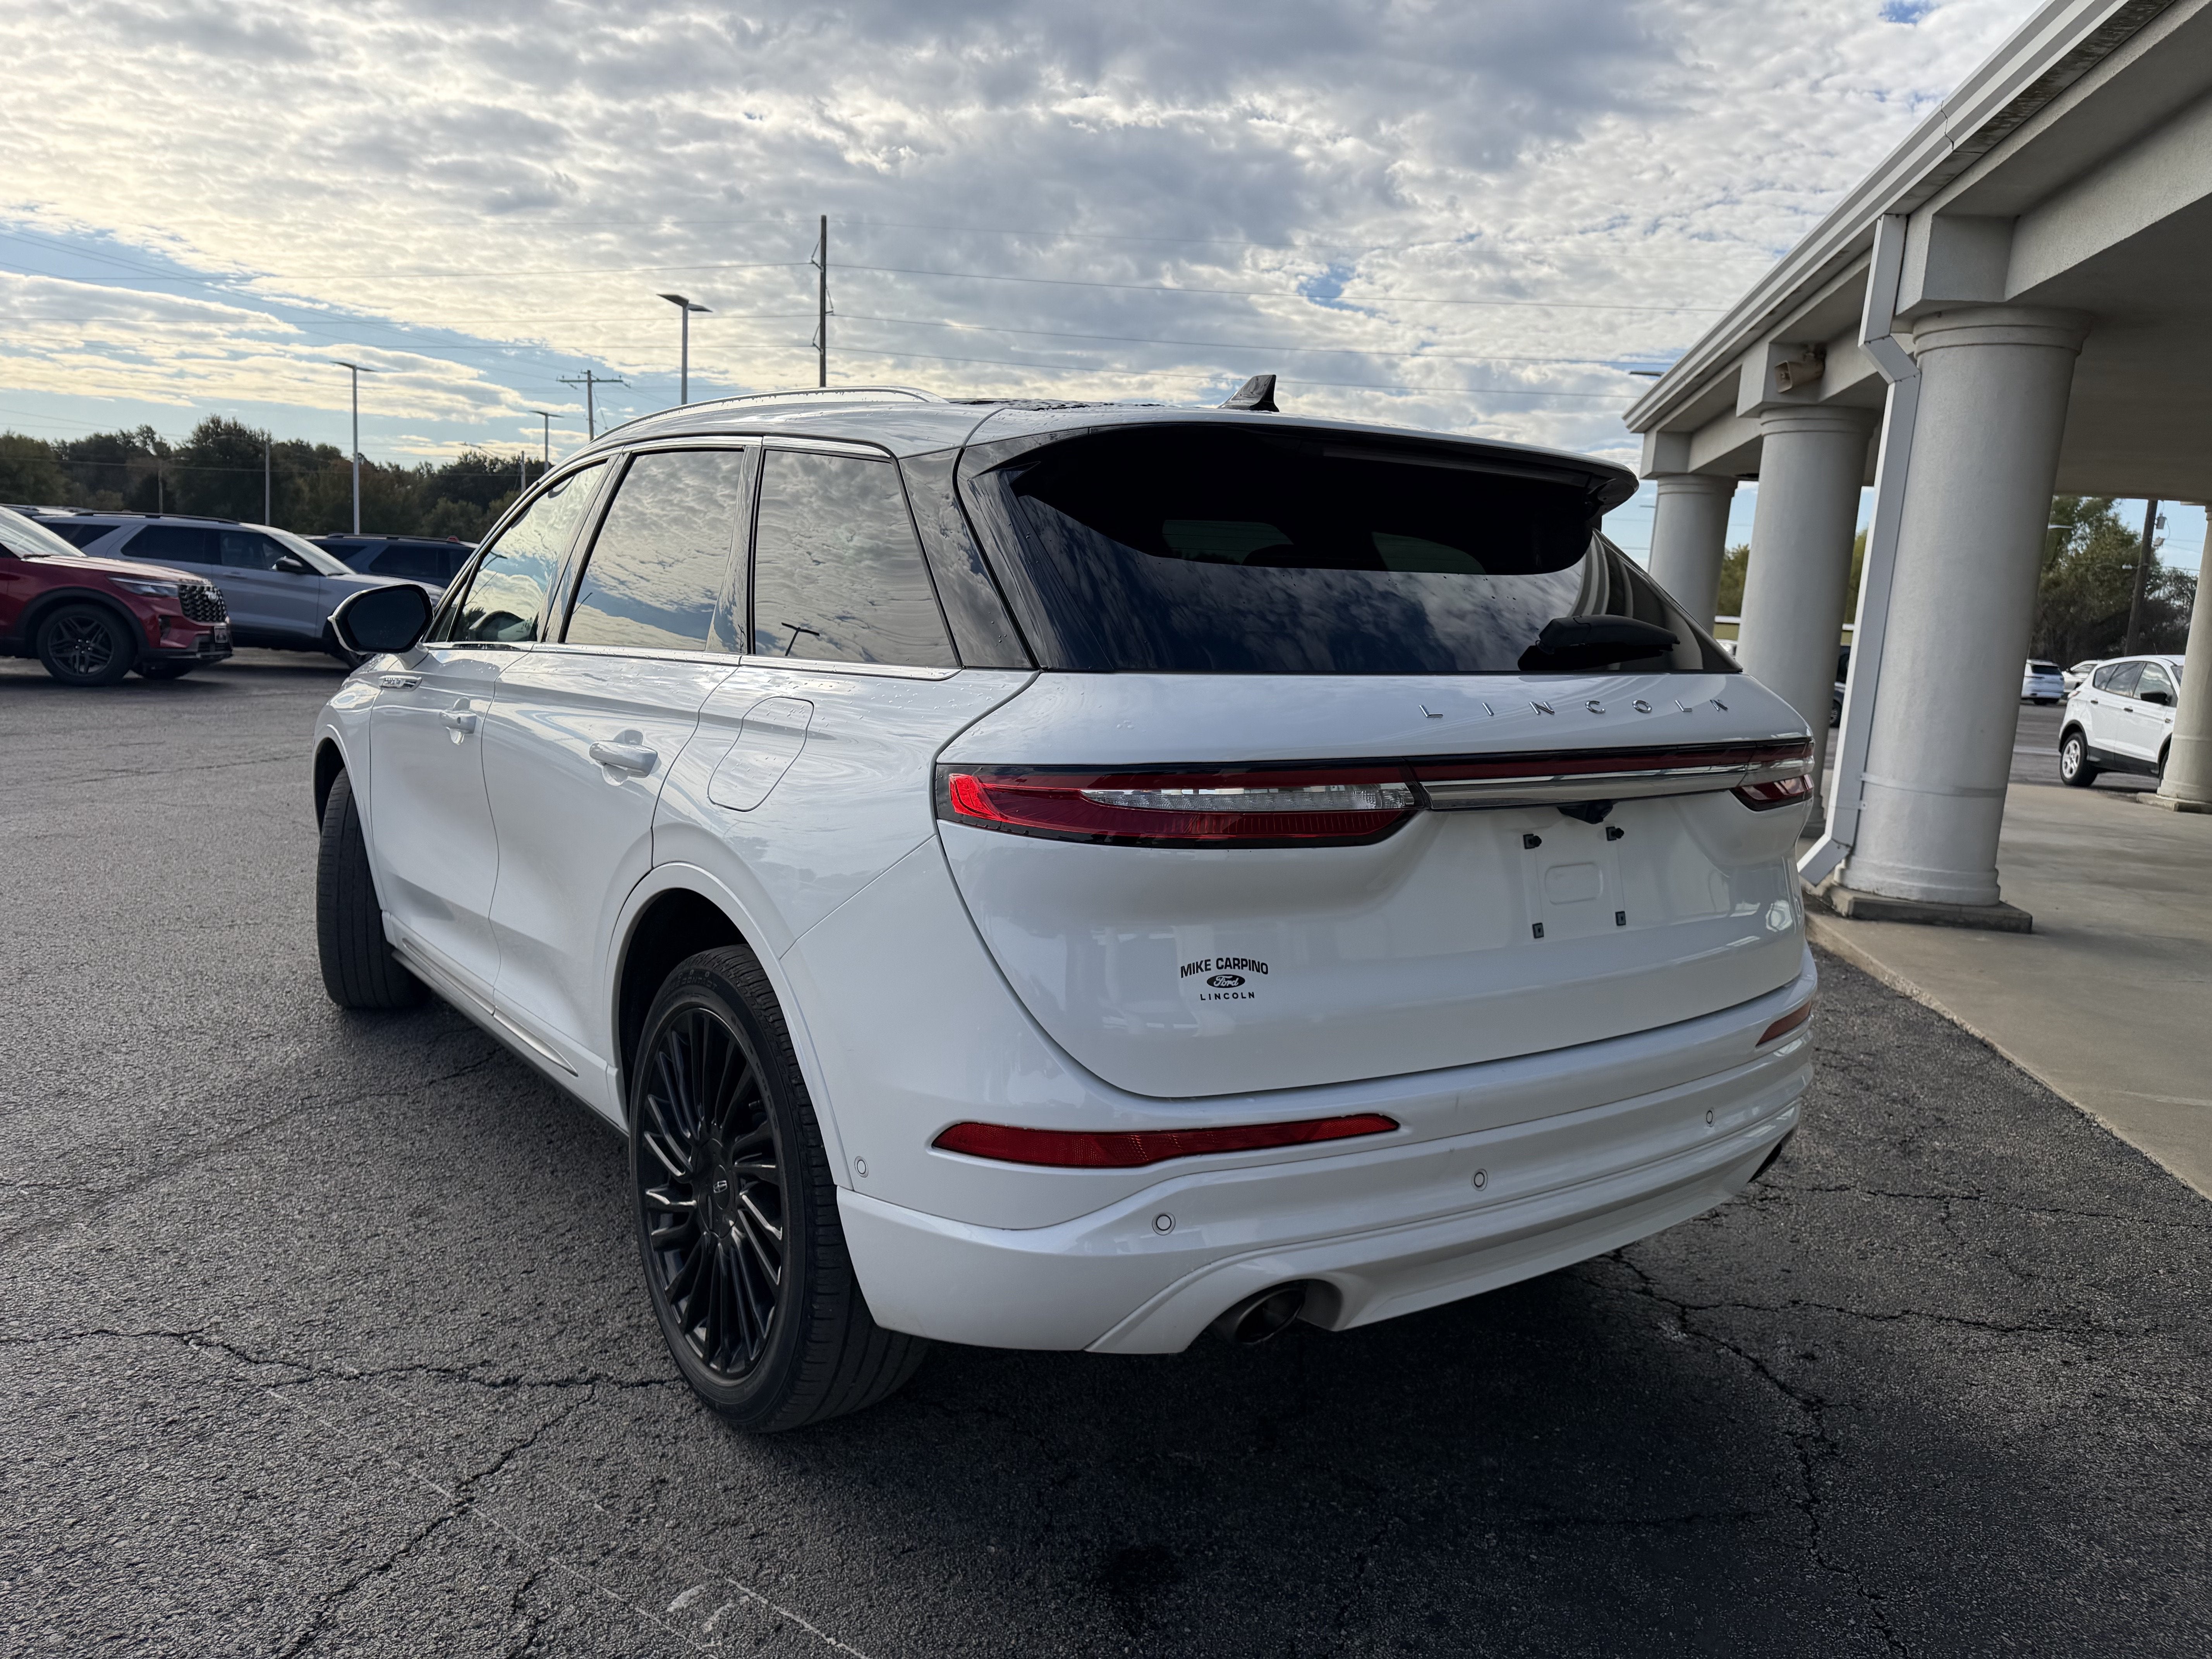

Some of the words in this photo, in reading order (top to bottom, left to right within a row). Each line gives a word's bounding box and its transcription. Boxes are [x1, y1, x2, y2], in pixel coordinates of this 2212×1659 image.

[1419, 699, 1728, 718] LINCOLN
[1180, 959, 1211, 978] MIKE
[1216, 958, 1269, 975] CARPINO
[1213, 975, 1239, 987] Ford
[1200, 992, 1255, 1001] LINCOLN
